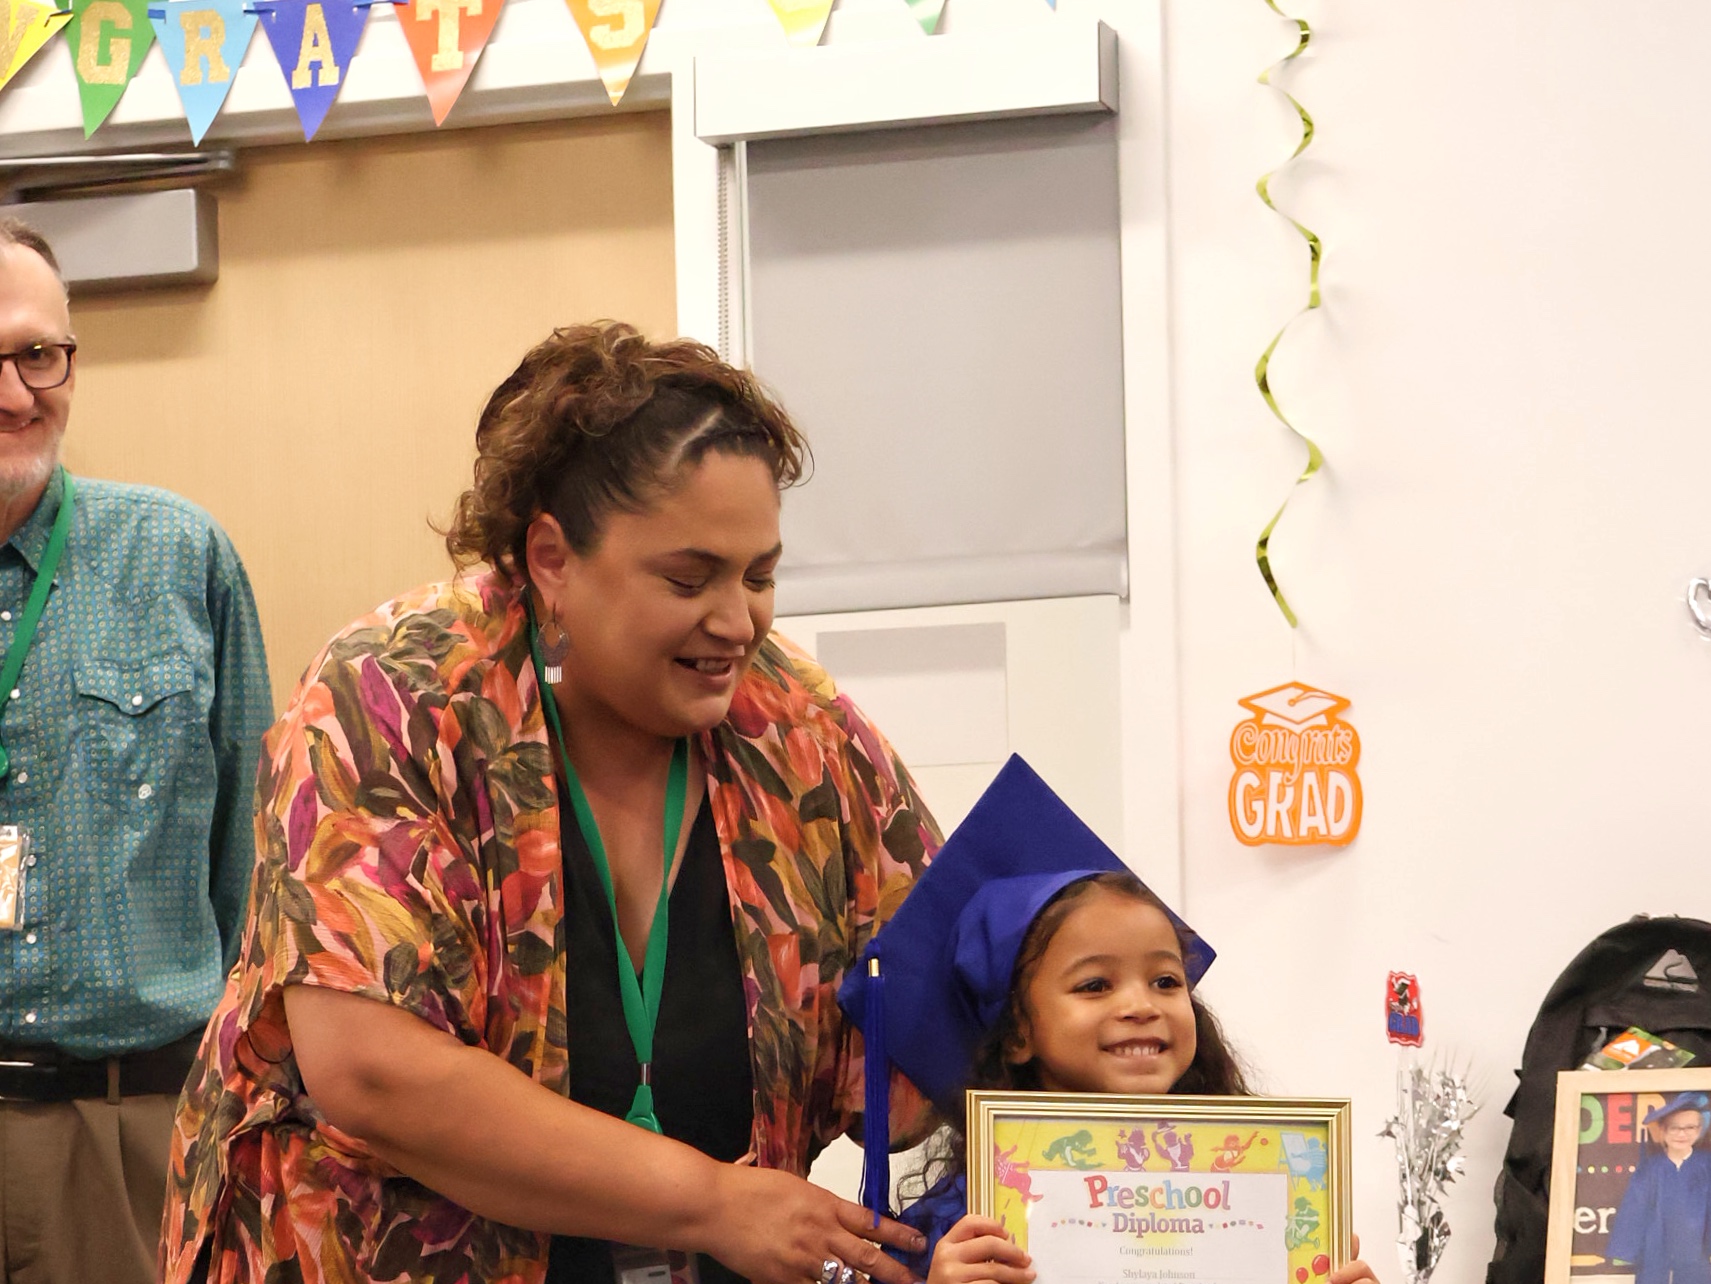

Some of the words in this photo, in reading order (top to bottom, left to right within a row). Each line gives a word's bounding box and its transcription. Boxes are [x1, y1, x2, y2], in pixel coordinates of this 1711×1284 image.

[1233, 722, 1353, 785] Congrats
[1235, 770, 1354, 839] GRAD
[1084, 1175, 1231, 1211] Preschool
[1112, 1212, 1205, 1238] Diploma
[1119, 1246, 1194, 1258] Congratulations!
